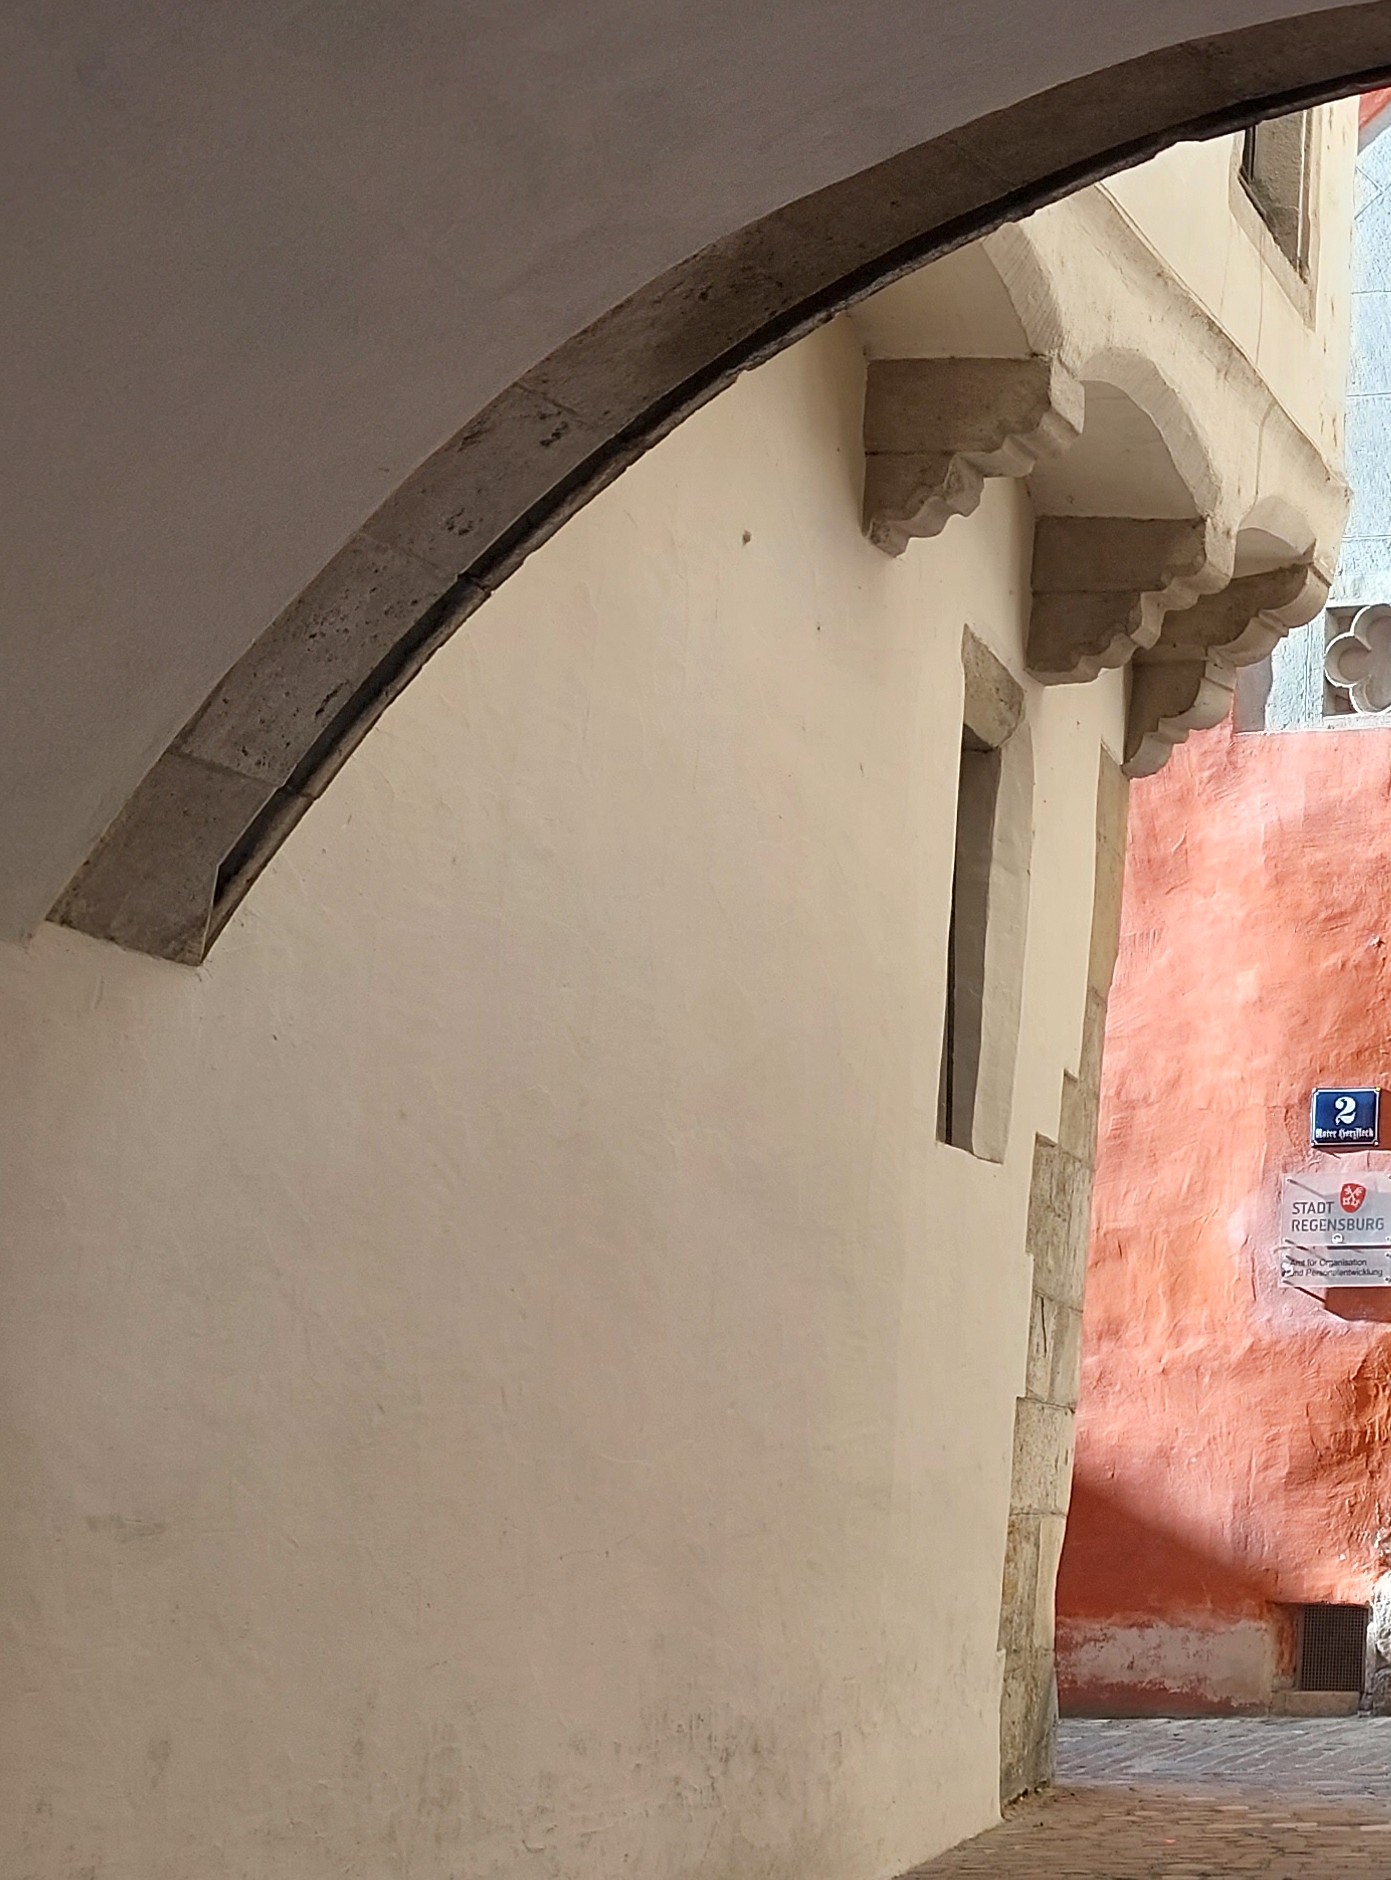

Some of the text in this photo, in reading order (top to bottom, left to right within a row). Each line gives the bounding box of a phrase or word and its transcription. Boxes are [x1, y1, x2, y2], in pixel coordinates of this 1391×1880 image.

[1334, 1096, 1357, 1126] 2
[1291, 1201, 1336, 1215] STADT
[1291, 1218, 1385, 1232] REGENSBURG
[1319, 1258, 1368, 1268] Organisation
